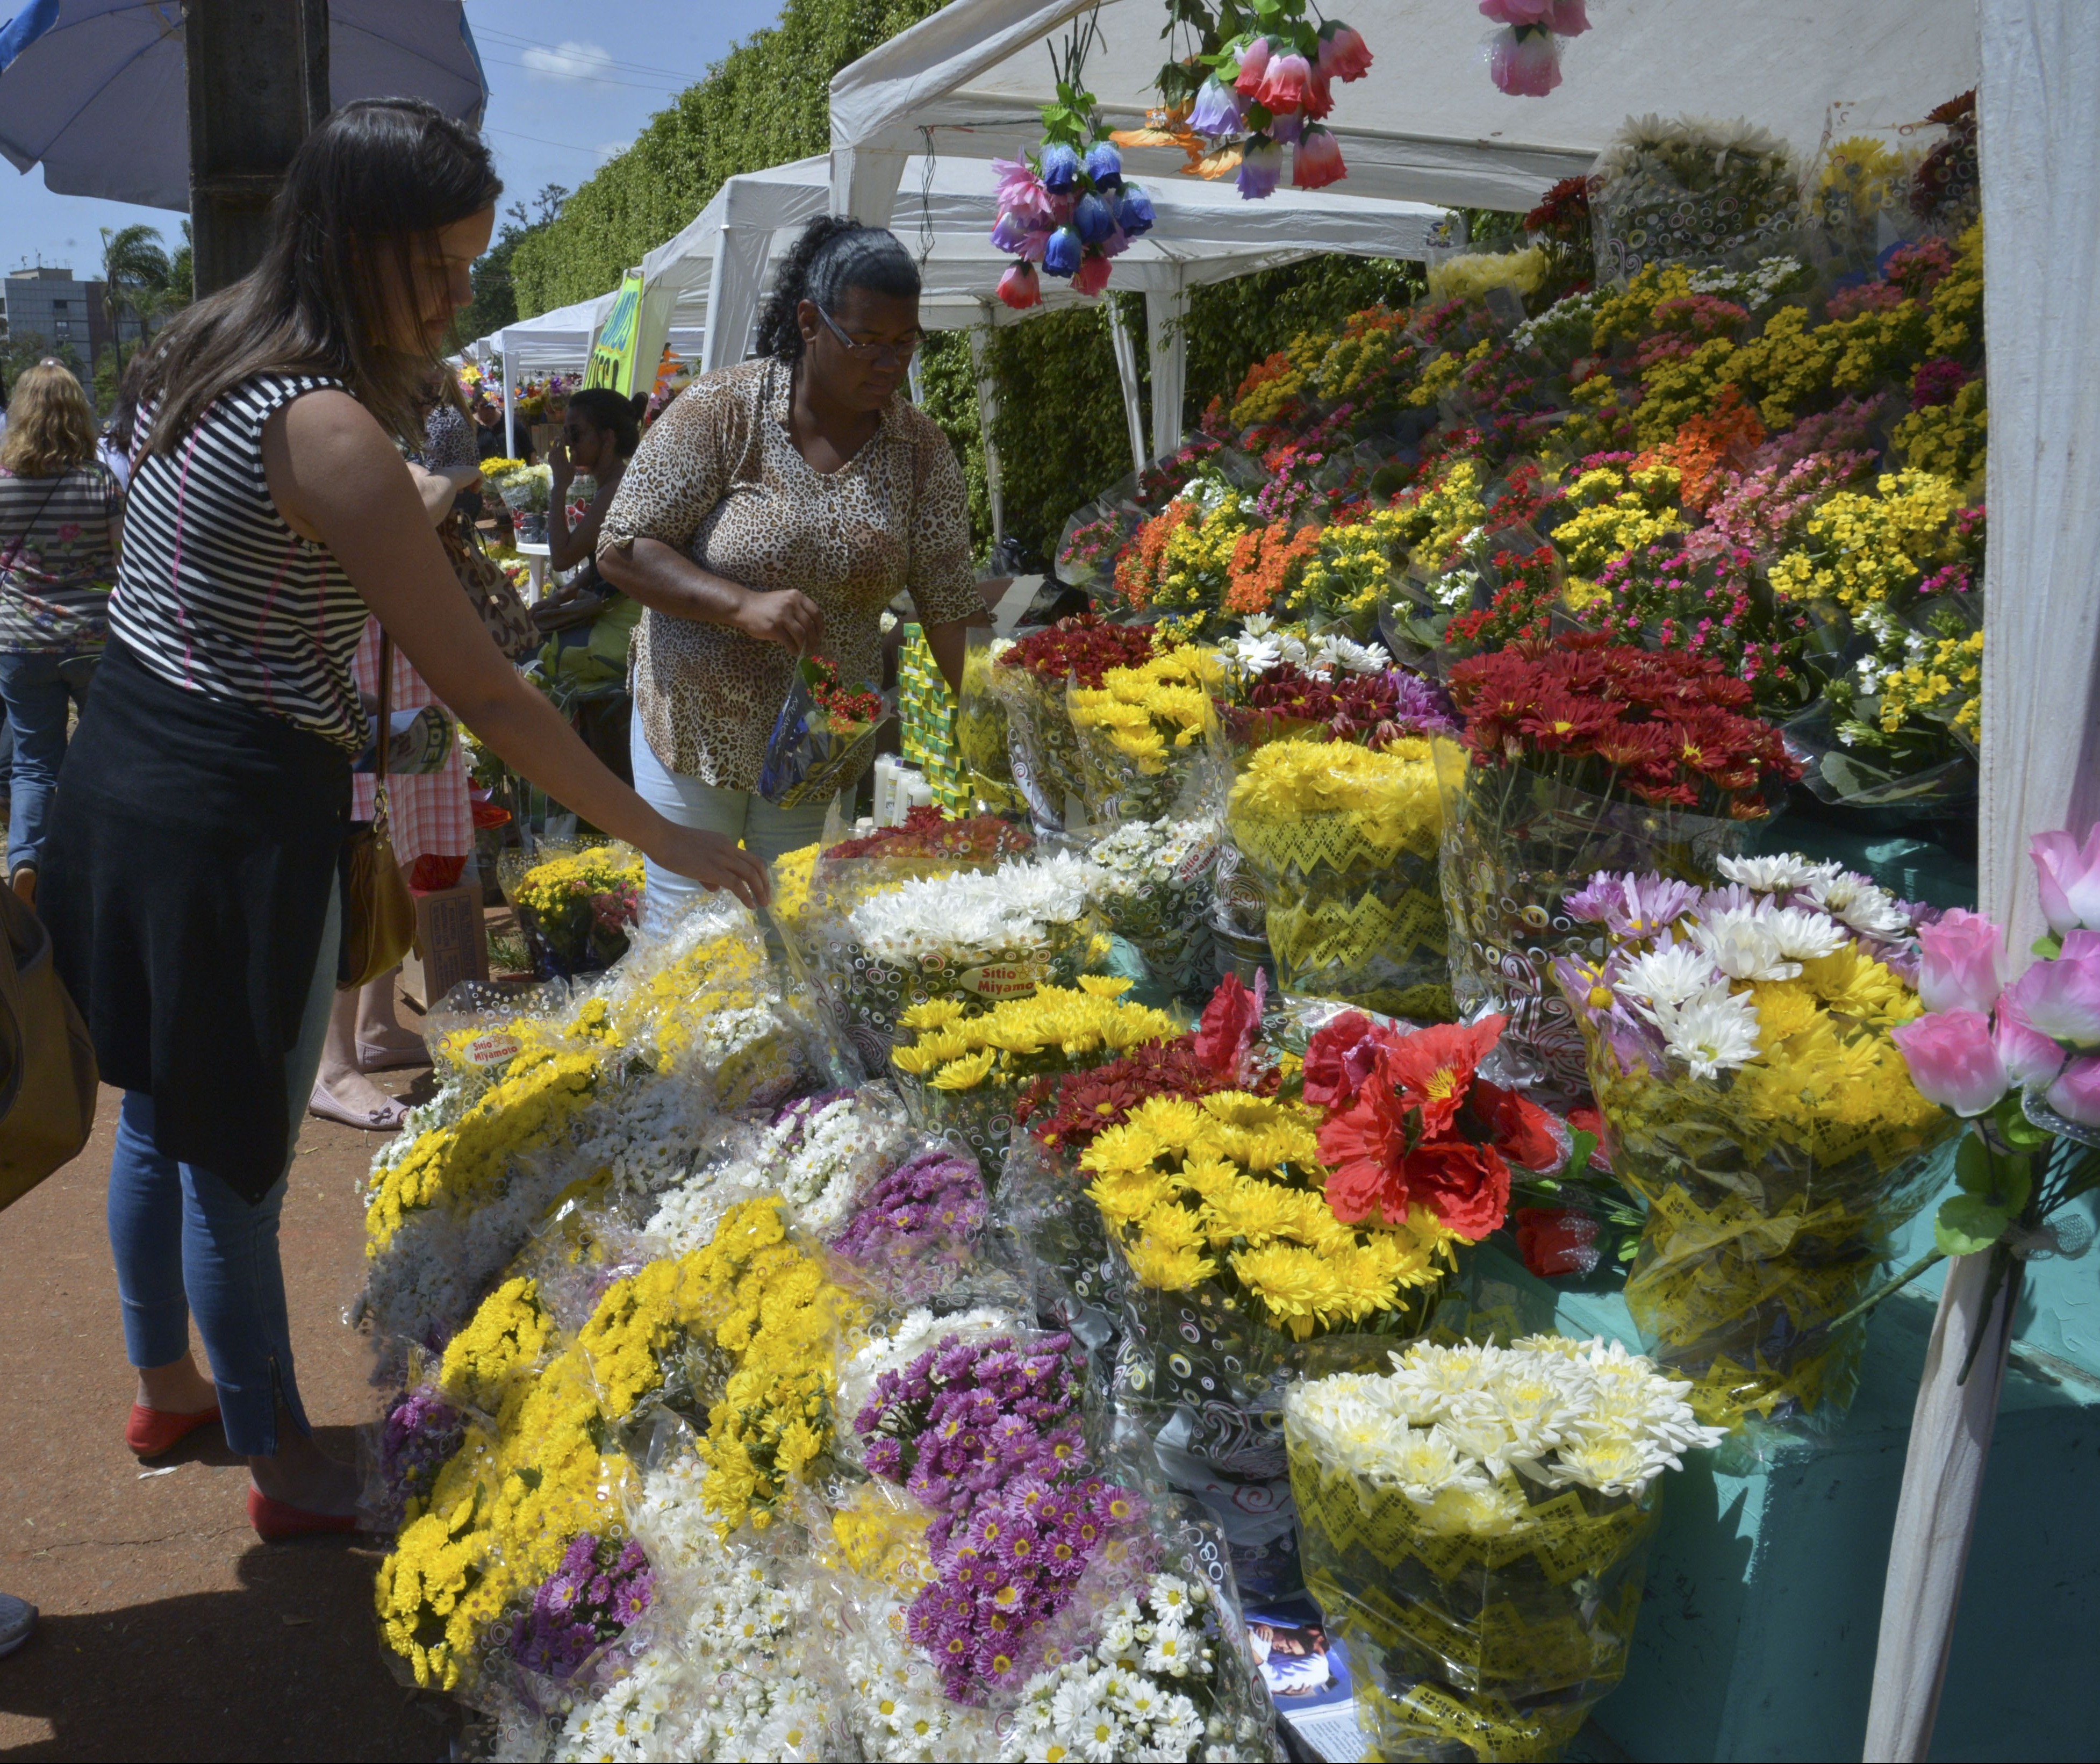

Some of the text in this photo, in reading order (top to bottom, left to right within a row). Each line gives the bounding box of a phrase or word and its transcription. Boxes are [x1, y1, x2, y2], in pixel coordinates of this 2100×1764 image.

[1179, 854, 1199, 875] Sítio
[982, 967, 1016, 979] Sítio
[473, 1041, 492, 1051] Sítio
[474, 1046, 518, 1062] Miyamoto
